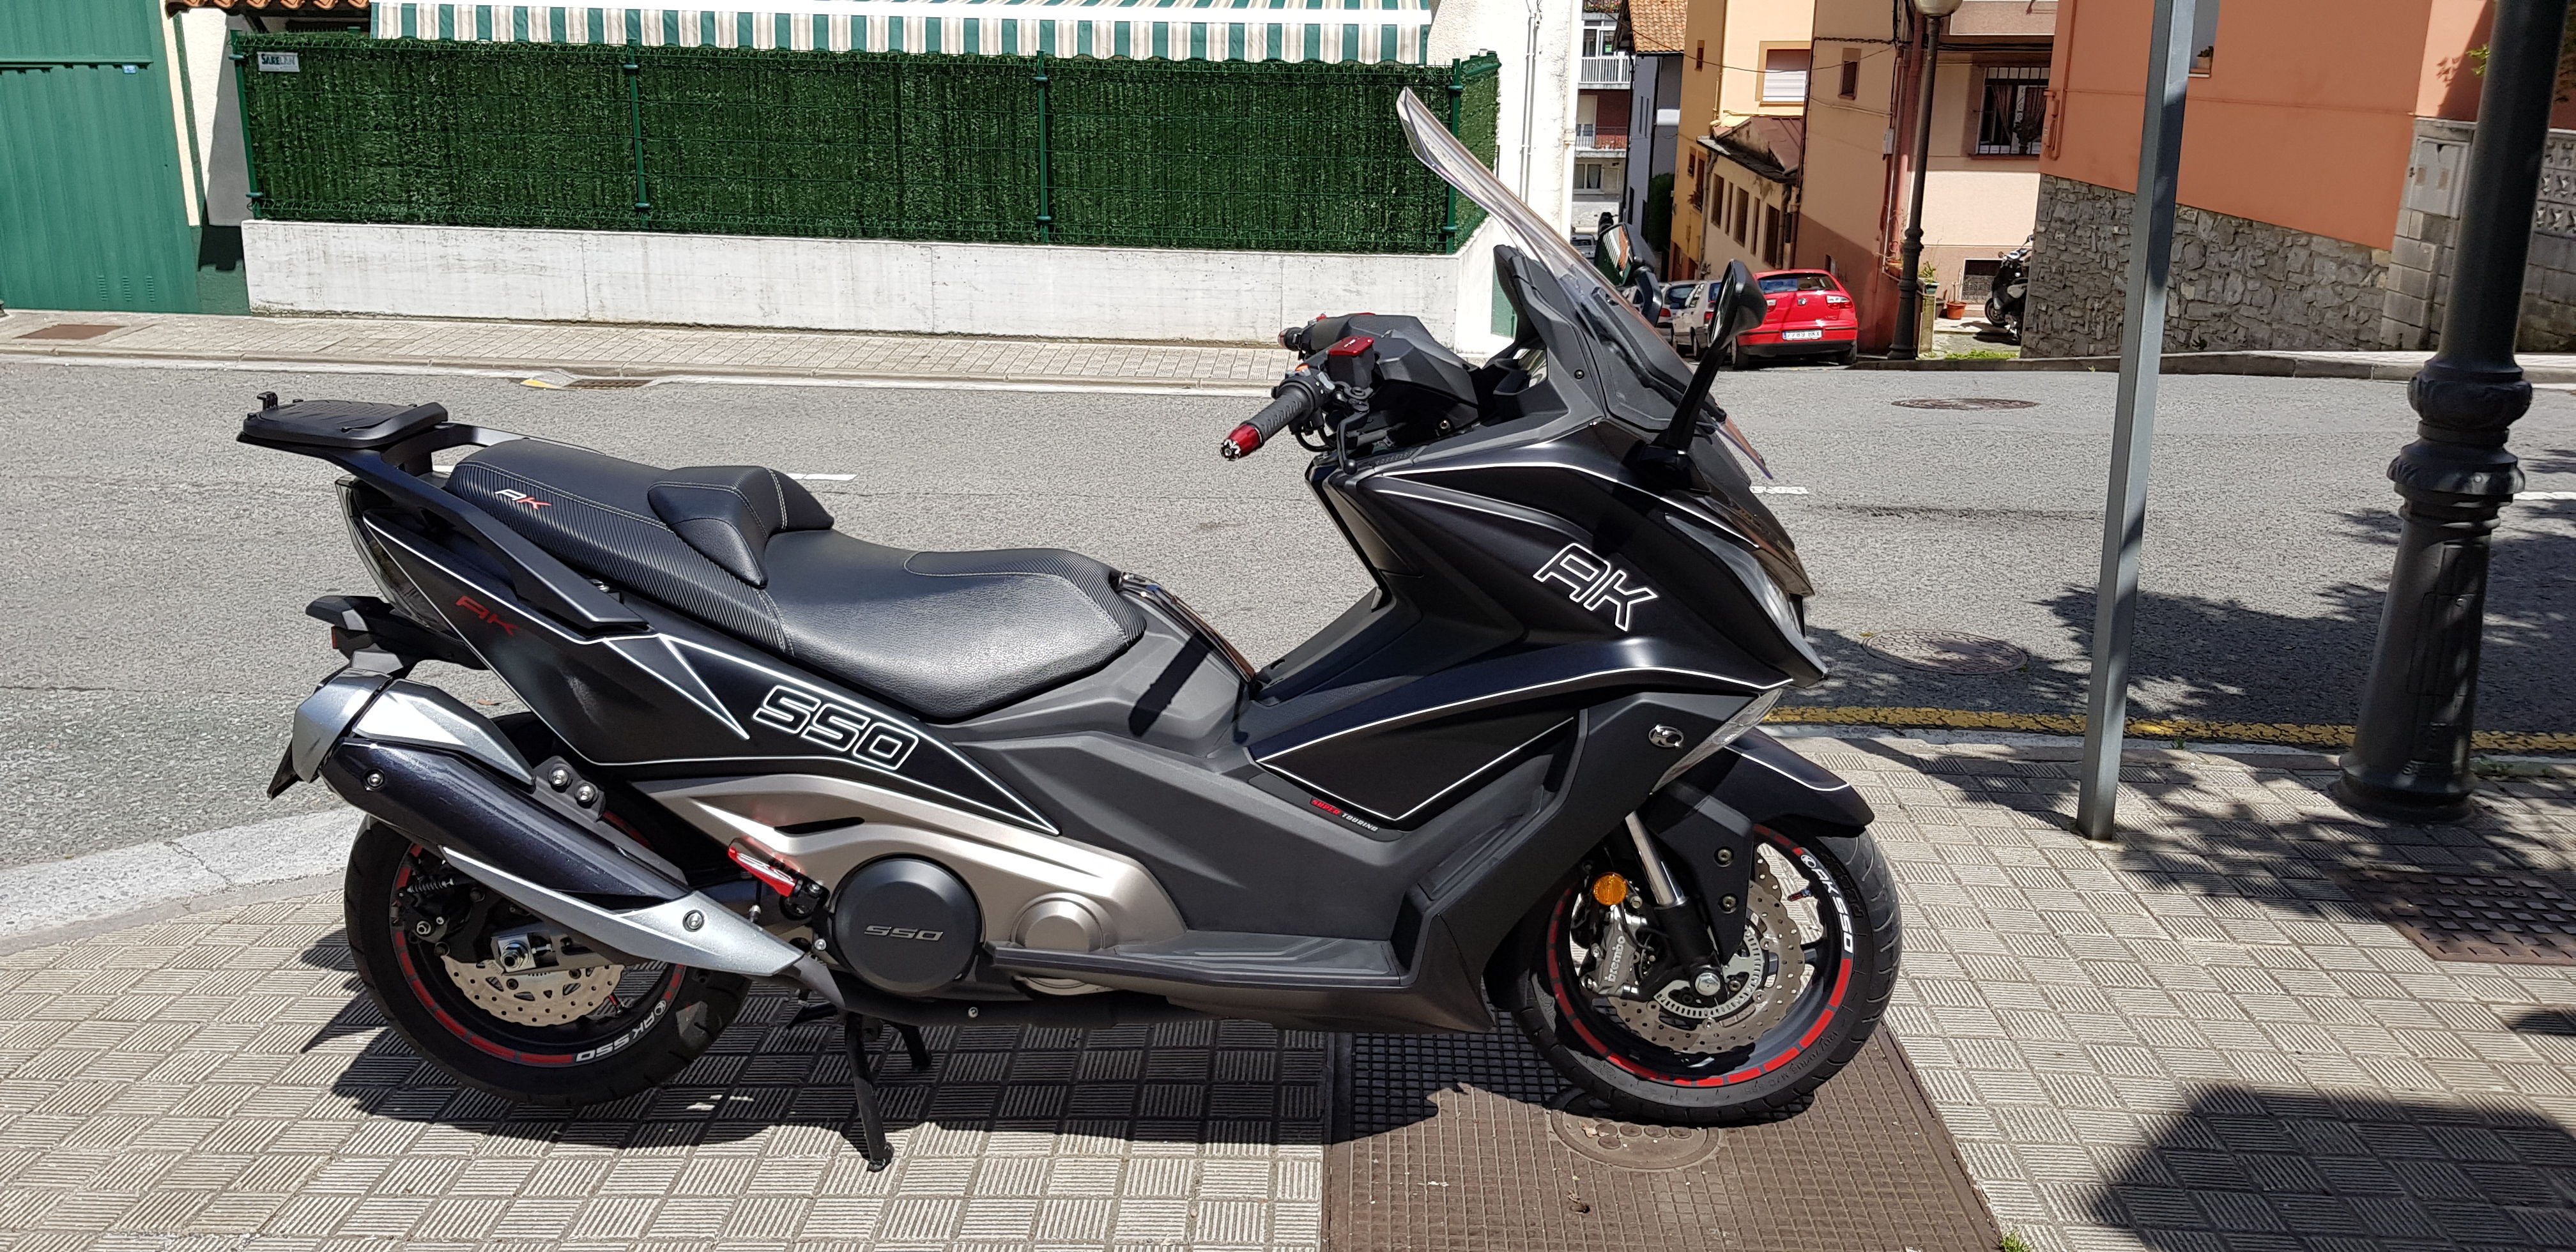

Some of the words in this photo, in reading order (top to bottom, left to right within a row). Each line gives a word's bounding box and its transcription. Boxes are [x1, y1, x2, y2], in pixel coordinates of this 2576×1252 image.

[494, 489, 552, 510] AK
[1533, 542, 1659, 632] AK
[456, 595, 518, 636] AK
[752, 685, 919, 770] 550
[1310, 798, 1342, 816] SUPER
[864, 925, 944, 941] 550
[1604, 935, 1626, 982] brembo
